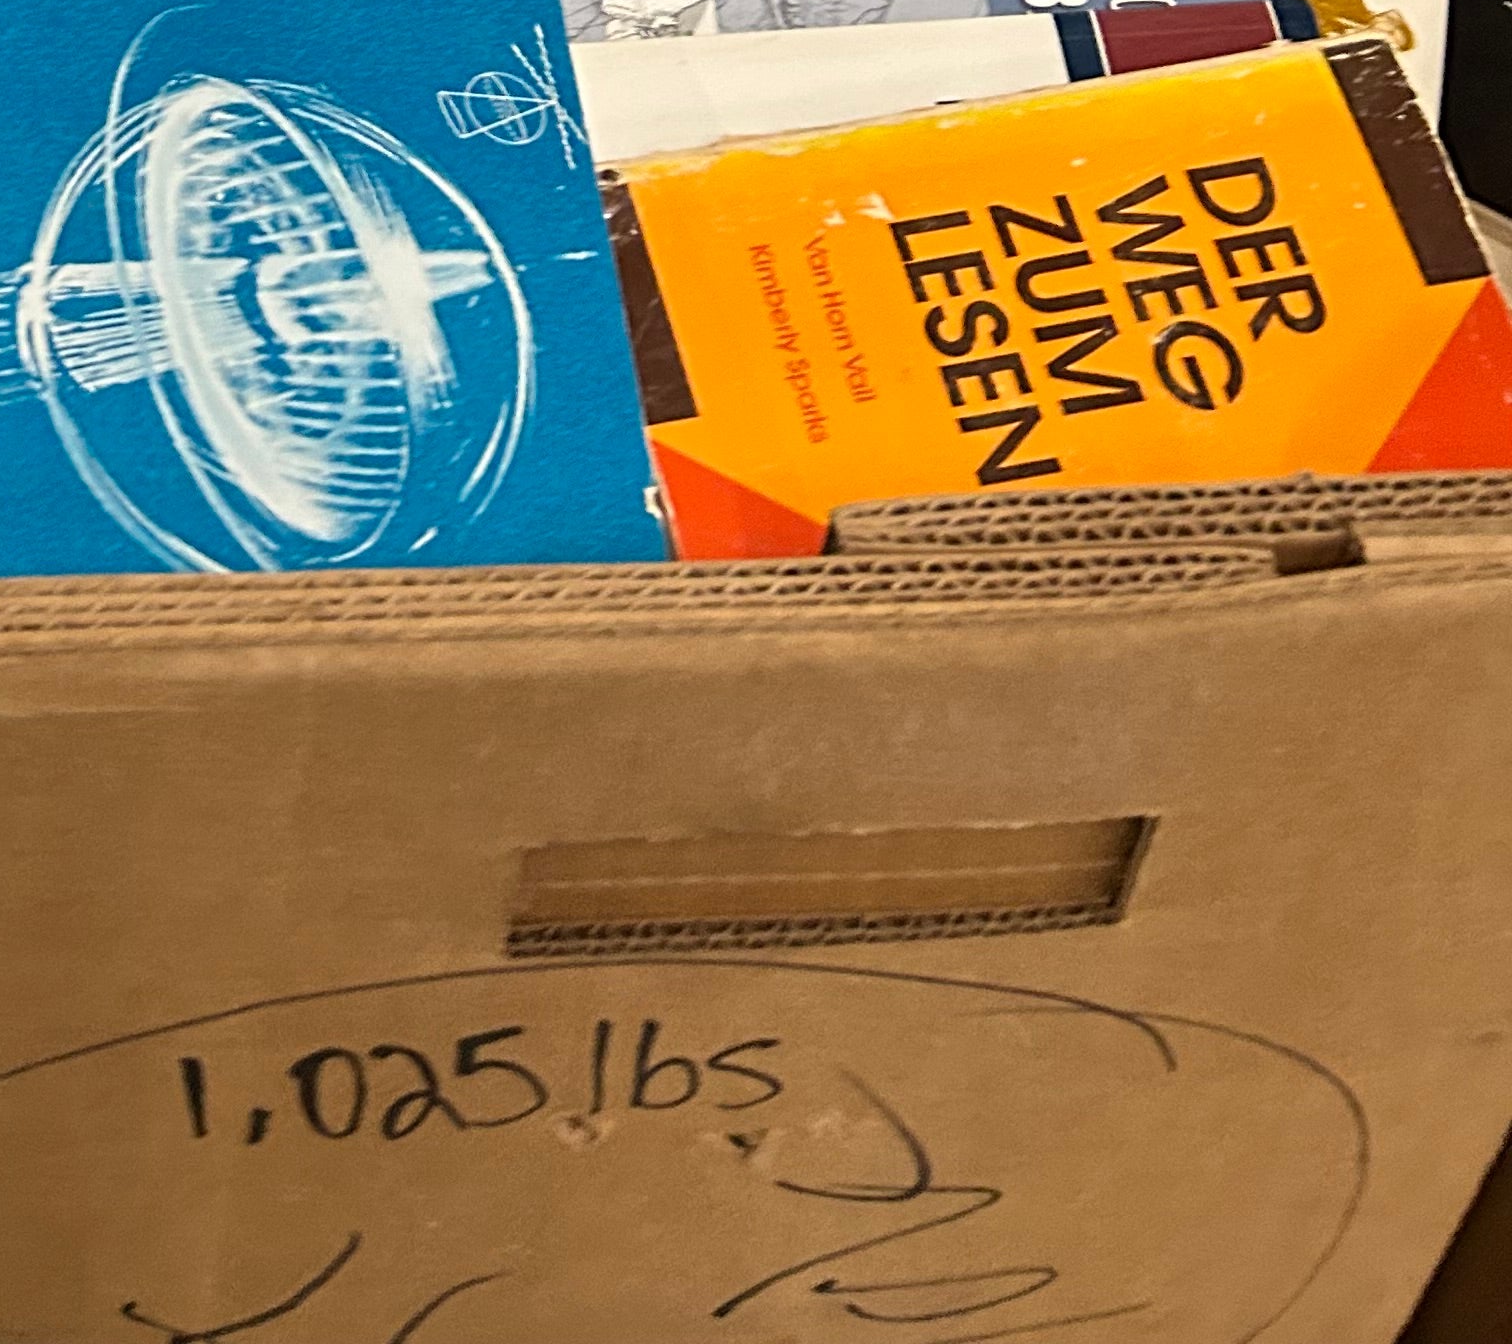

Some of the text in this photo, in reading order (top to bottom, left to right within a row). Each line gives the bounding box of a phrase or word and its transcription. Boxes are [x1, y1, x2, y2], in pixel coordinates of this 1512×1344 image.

[748, 243, 830, 444] Kimberly Sparks
[804, 234, 878, 403] Van Horn Vail
[889, 209, 1063, 486] LESEN
[987, 194, 1147, 416] ZUM
[1097, 175, 1244, 411] WEG
[1186, 157, 1327, 341] DER
[179, 1019, 784, 1144] 1,025 lbs
